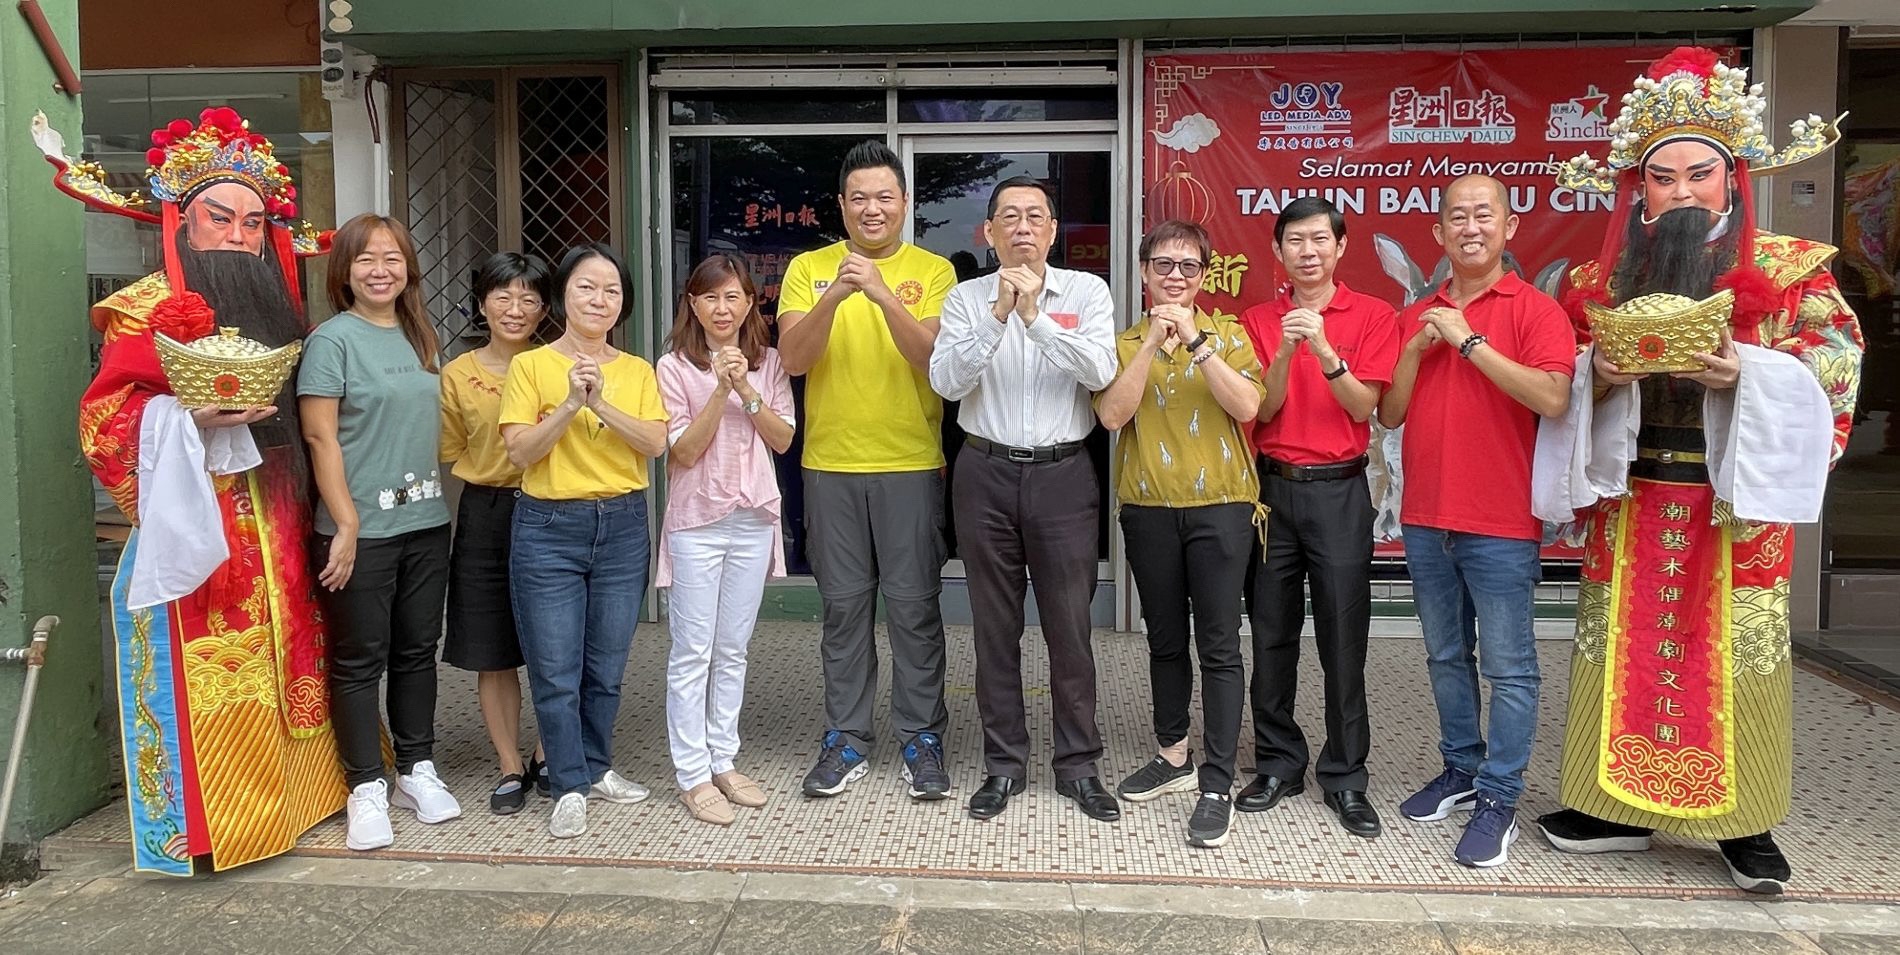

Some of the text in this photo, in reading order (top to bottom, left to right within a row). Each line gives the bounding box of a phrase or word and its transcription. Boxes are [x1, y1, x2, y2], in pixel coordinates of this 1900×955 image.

[1391, 130, 1513, 142] SIN CHEW DAILY
[1299, 154, 1563, 177] Selamat Menyamb
